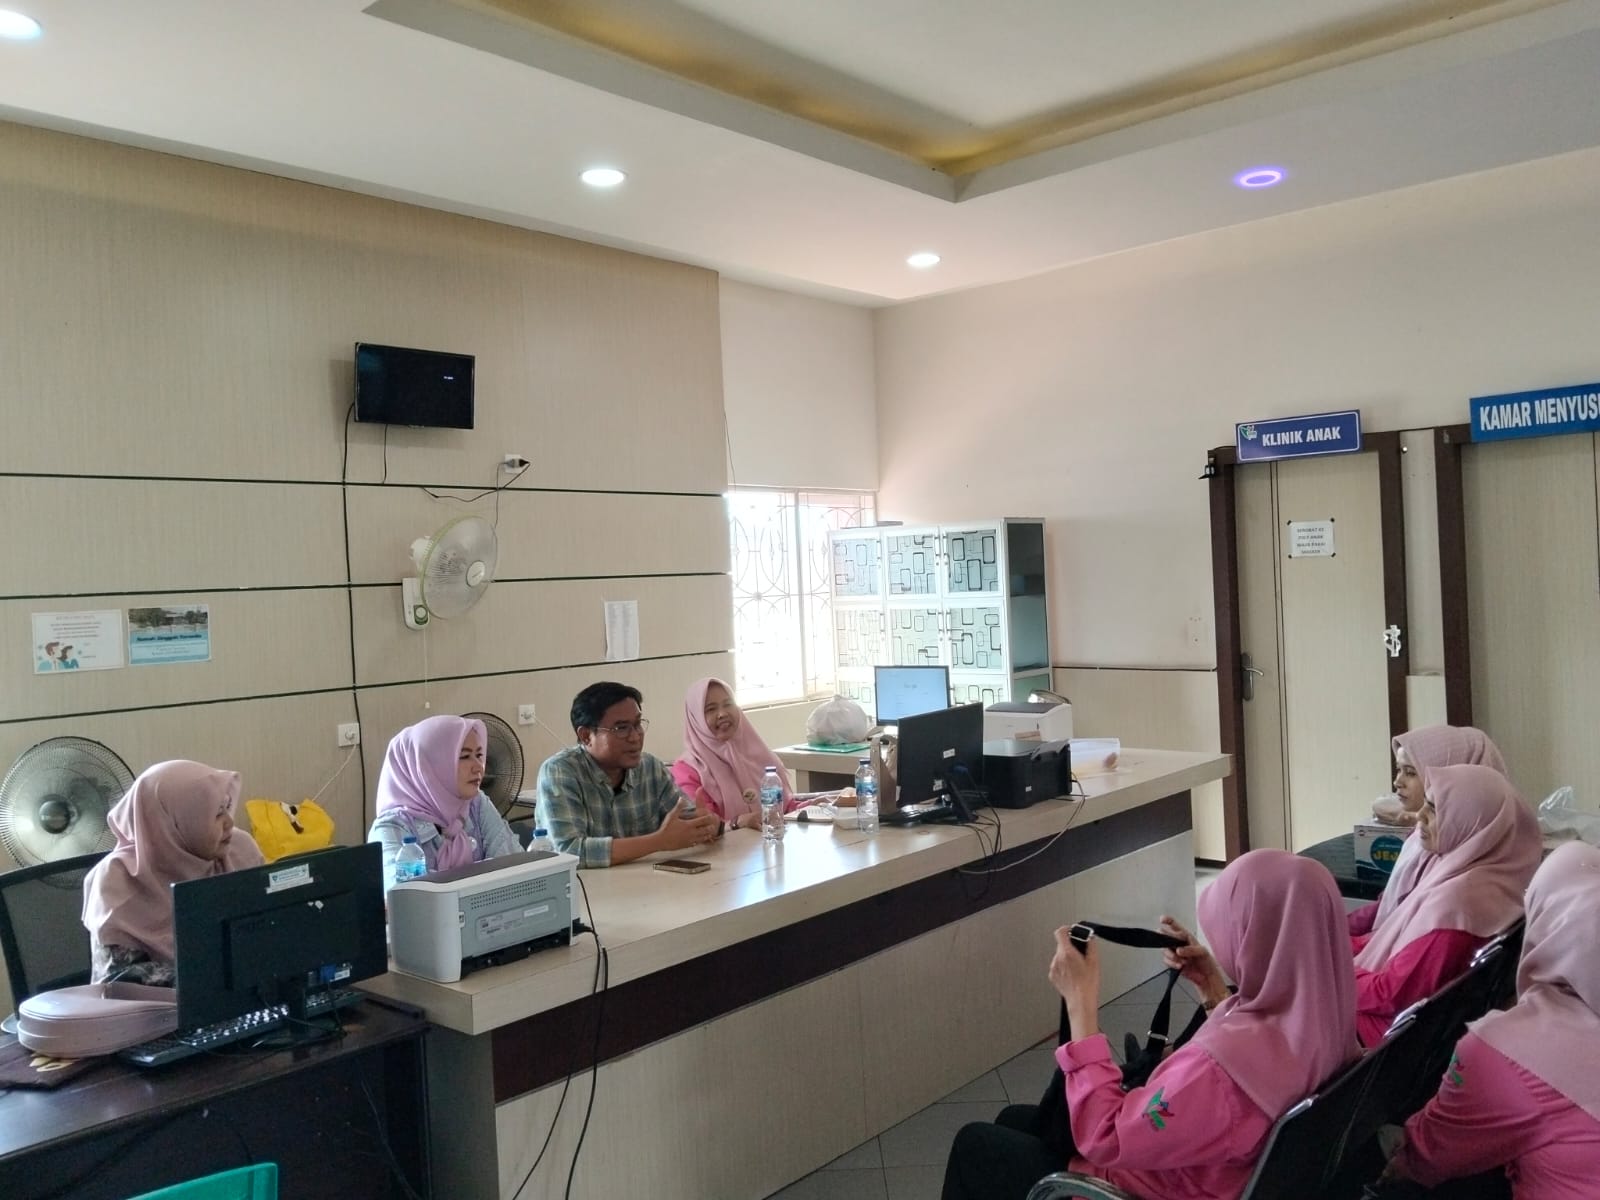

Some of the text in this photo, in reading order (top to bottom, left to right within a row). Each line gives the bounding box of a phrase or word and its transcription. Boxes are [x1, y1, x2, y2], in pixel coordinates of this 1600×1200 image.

[1480, 393, 1600, 431] KAMAR MENYUS
[1262, 426, 1341, 447] KLINIK ANAK
[1372, 850, 1399, 861] JEJ
